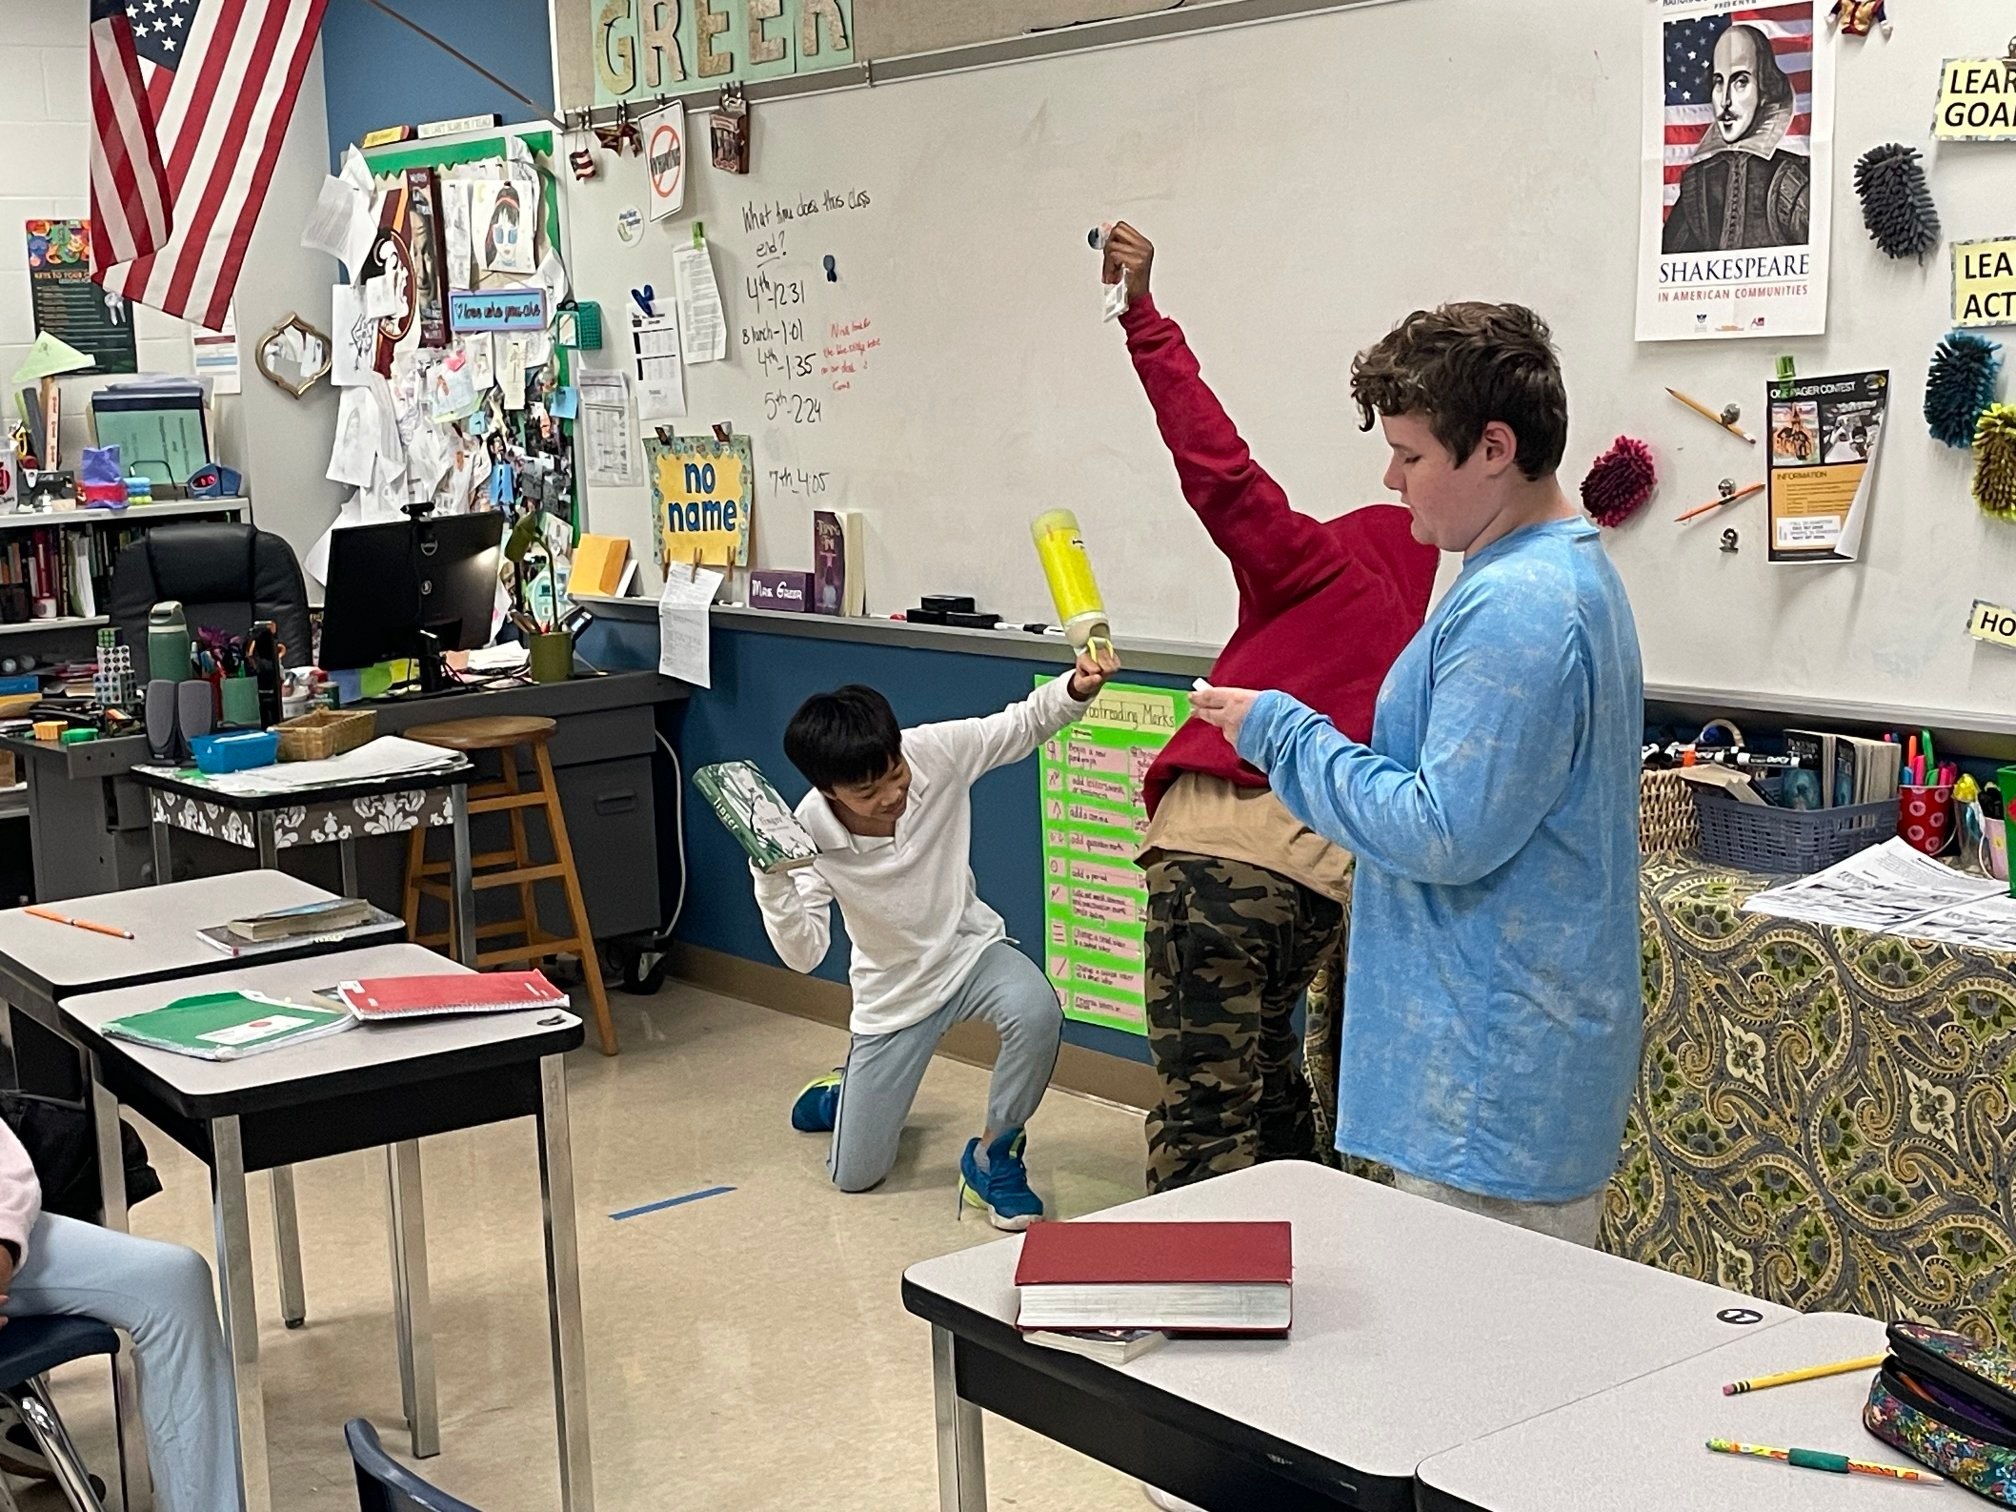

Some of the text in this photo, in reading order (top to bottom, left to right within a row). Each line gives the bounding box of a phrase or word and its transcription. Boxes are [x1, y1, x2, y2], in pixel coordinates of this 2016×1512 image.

[742, 200, 772, 233] What
[1659, 253, 1810, 284] SHAKESPEARE
[1964, 252, 2014, 279] LEA
[1658, 284, 1808, 302] IN AMERICAN COMMUNITIES
[1963, 291, 2016, 319] ACT
[1820, 381, 1857, 395] CONTEST
[684, 463, 716, 494] no
[1776, 471, 1828, 480] INFORMATION
[668, 500, 737, 532] name
[1980, 611, 2016, 637] HO
[1143, 703, 1175, 728] Marks
